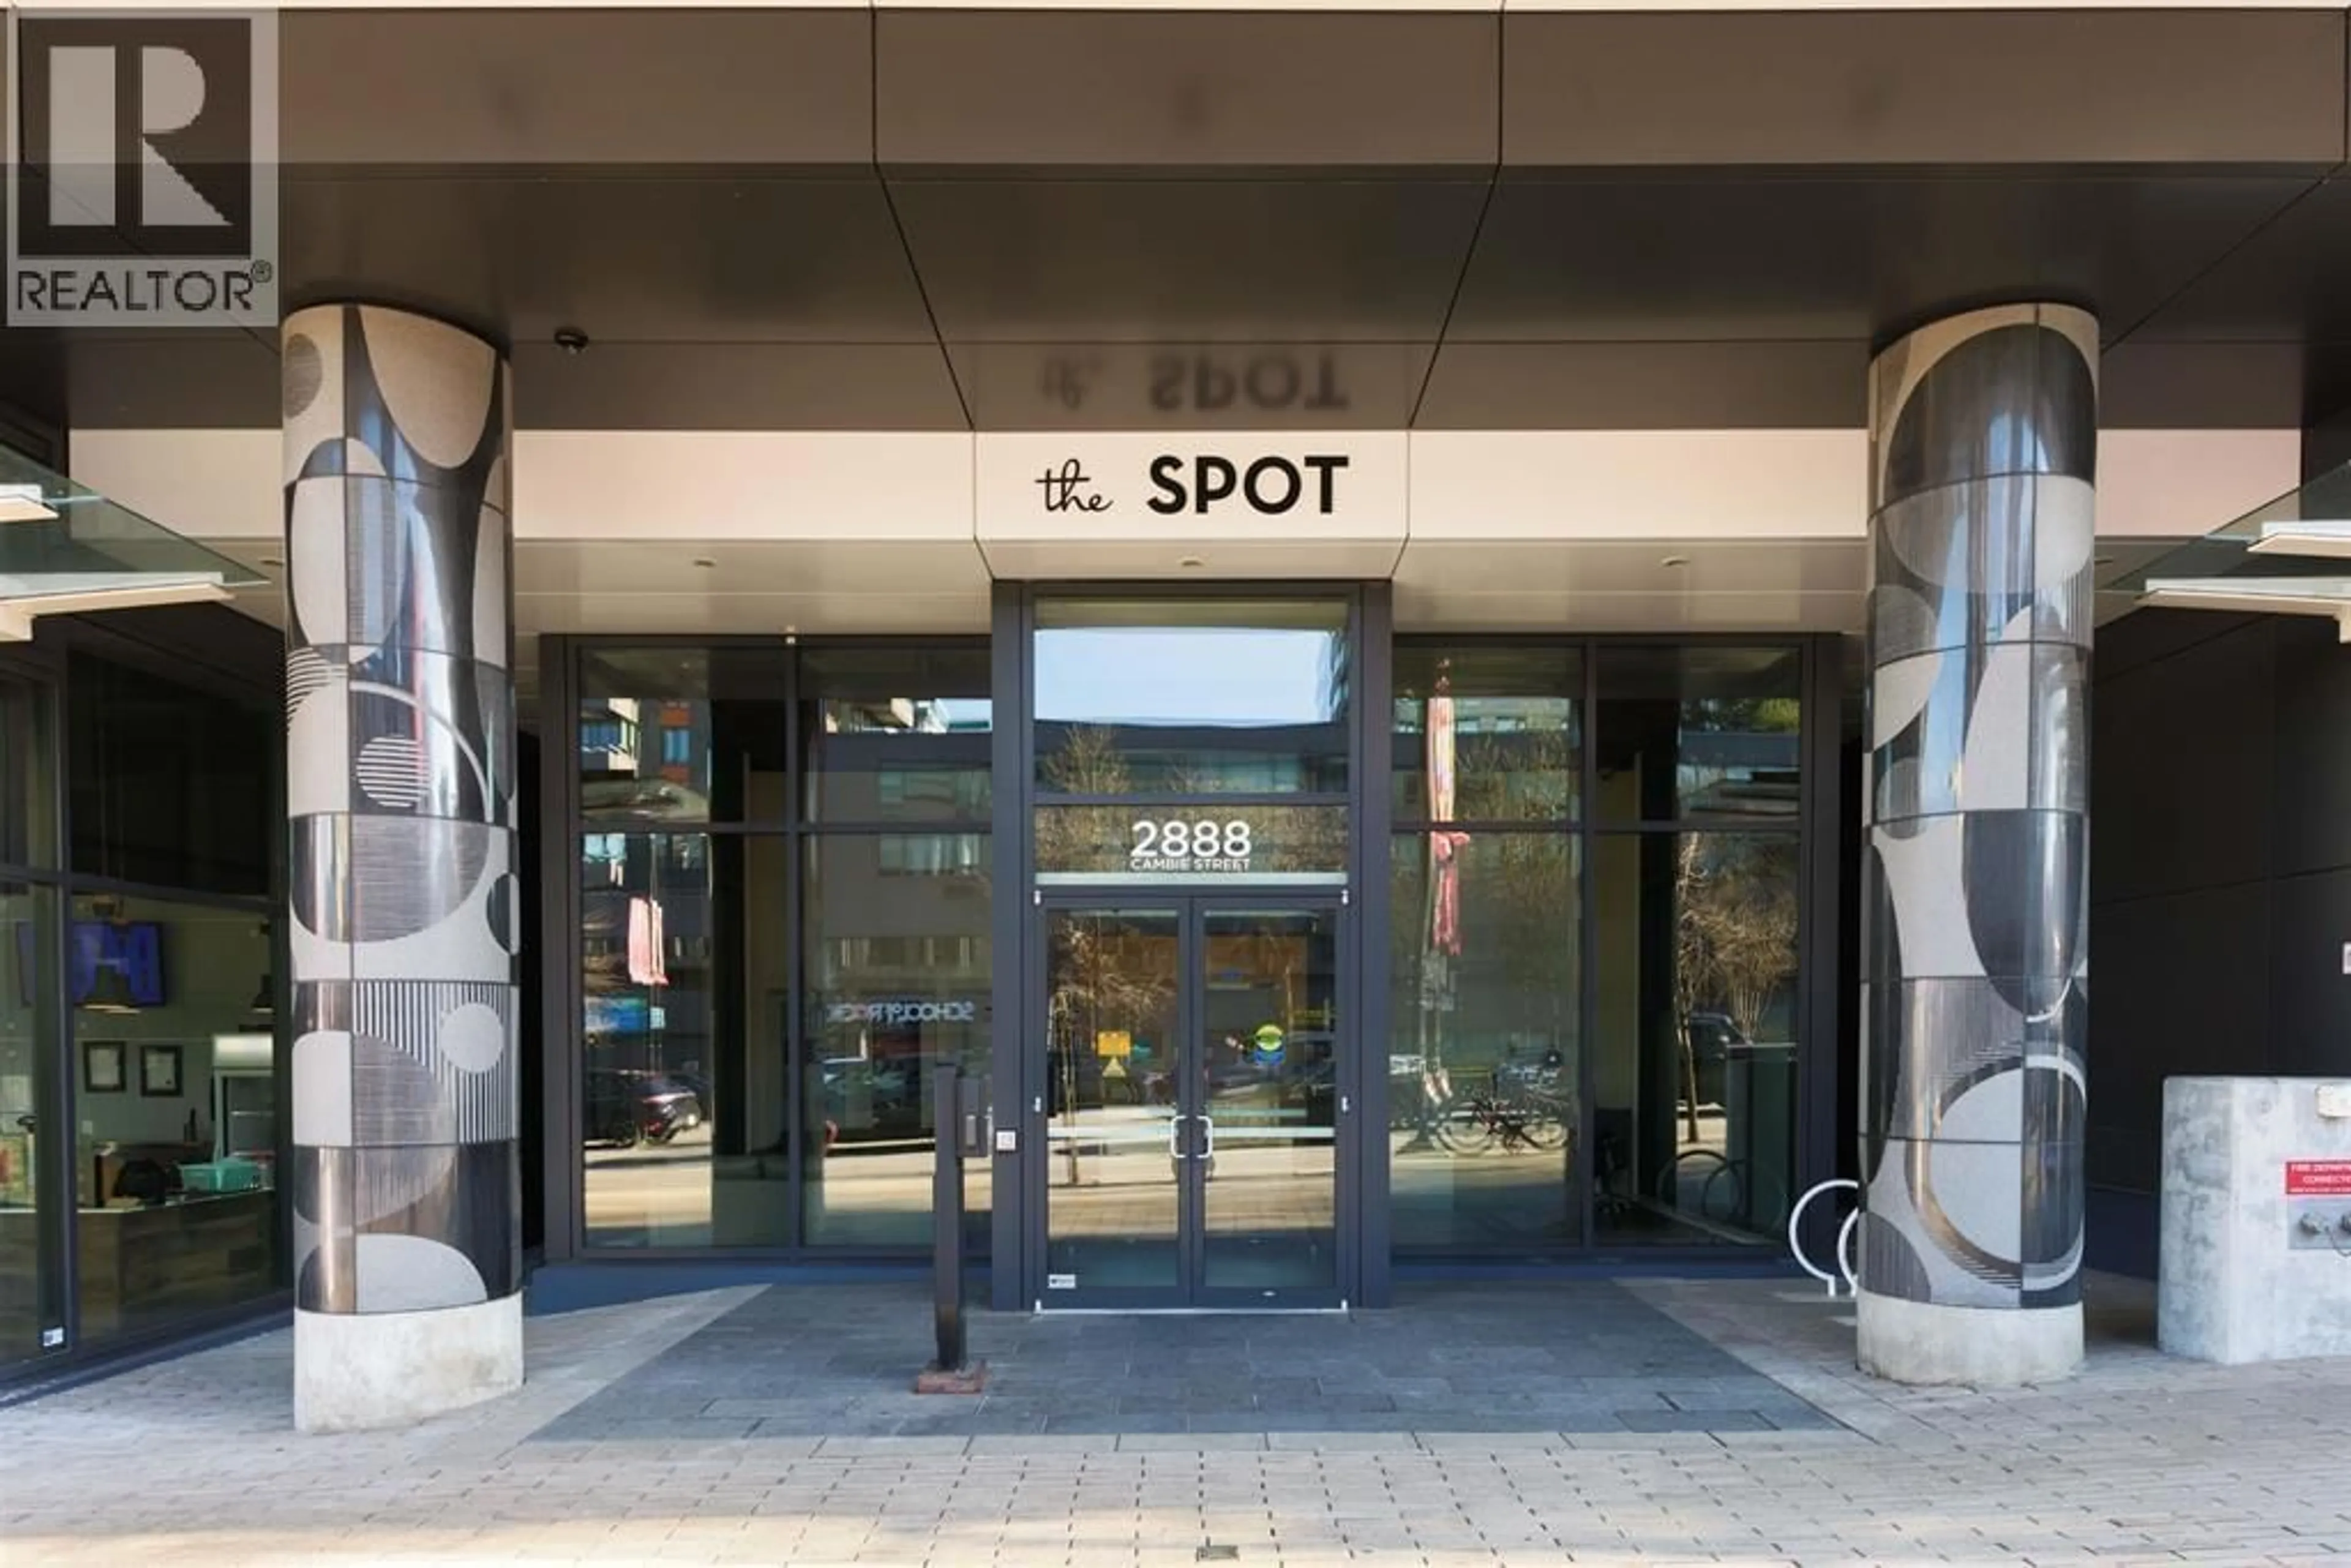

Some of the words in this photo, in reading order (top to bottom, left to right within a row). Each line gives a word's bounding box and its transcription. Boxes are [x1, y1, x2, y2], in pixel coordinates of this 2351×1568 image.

[1035, 458, 1114, 512] the
[1146, 454, 1349, 515] SPOT
[1130, 819, 1251, 858] 2888
[1130, 858, 1190, 871] CAMBIE
[1193, 858, 1250, 871] STREET
